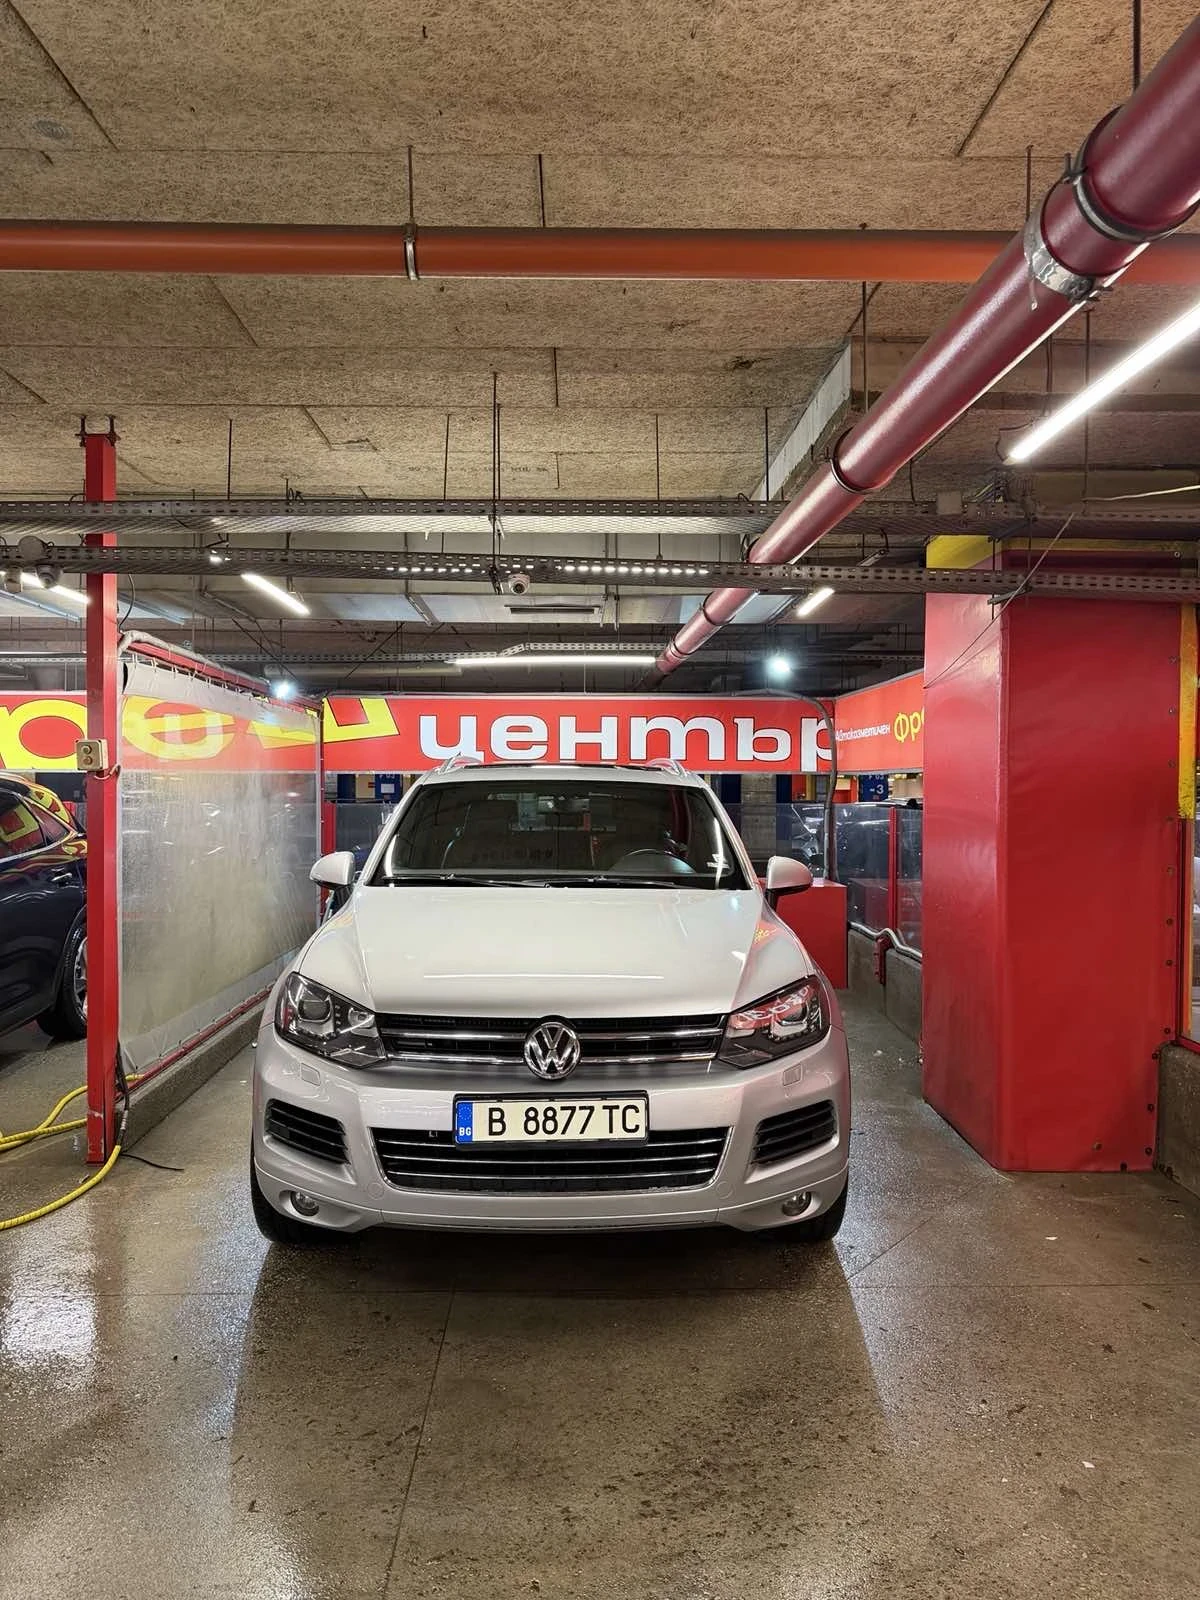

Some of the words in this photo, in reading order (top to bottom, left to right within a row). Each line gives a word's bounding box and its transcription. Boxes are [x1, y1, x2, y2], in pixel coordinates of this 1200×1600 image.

[418, 716, 834, 772] център
[458, 1127, 472, 1136] BG
[488, 1107, 507, 1136] B
[523, 1105, 595, 1135] 8877
[602, 1104, 640, 1134] TC
